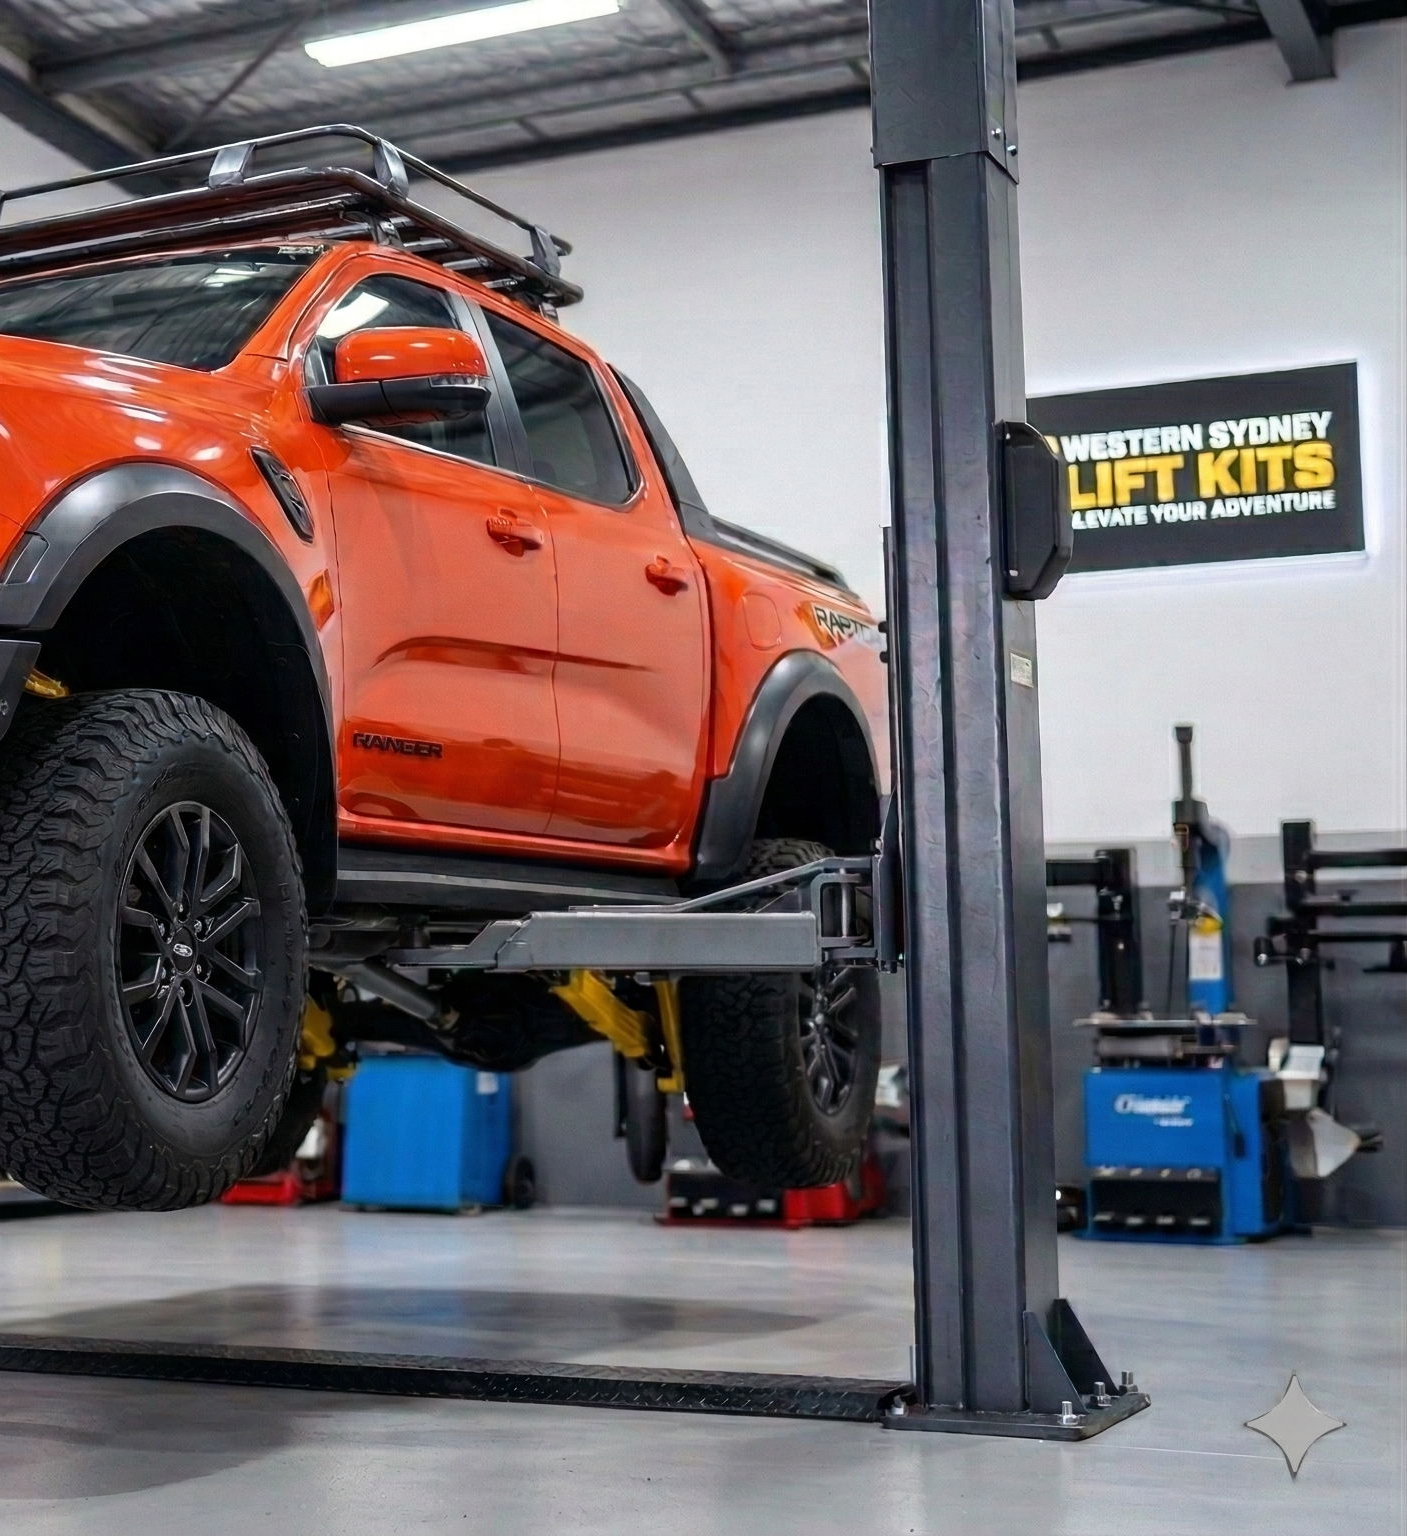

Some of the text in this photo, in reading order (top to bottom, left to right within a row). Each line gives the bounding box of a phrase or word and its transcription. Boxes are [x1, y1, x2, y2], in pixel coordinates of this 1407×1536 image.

[1061, 411, 1333, 462] WESTERN SYDNEY
[1068, 441, 1336, 511] LIFT KITS
[1149, 501, 1208, 525] YOUR
[1210, 490, 1336, 518] ADVENTURE
